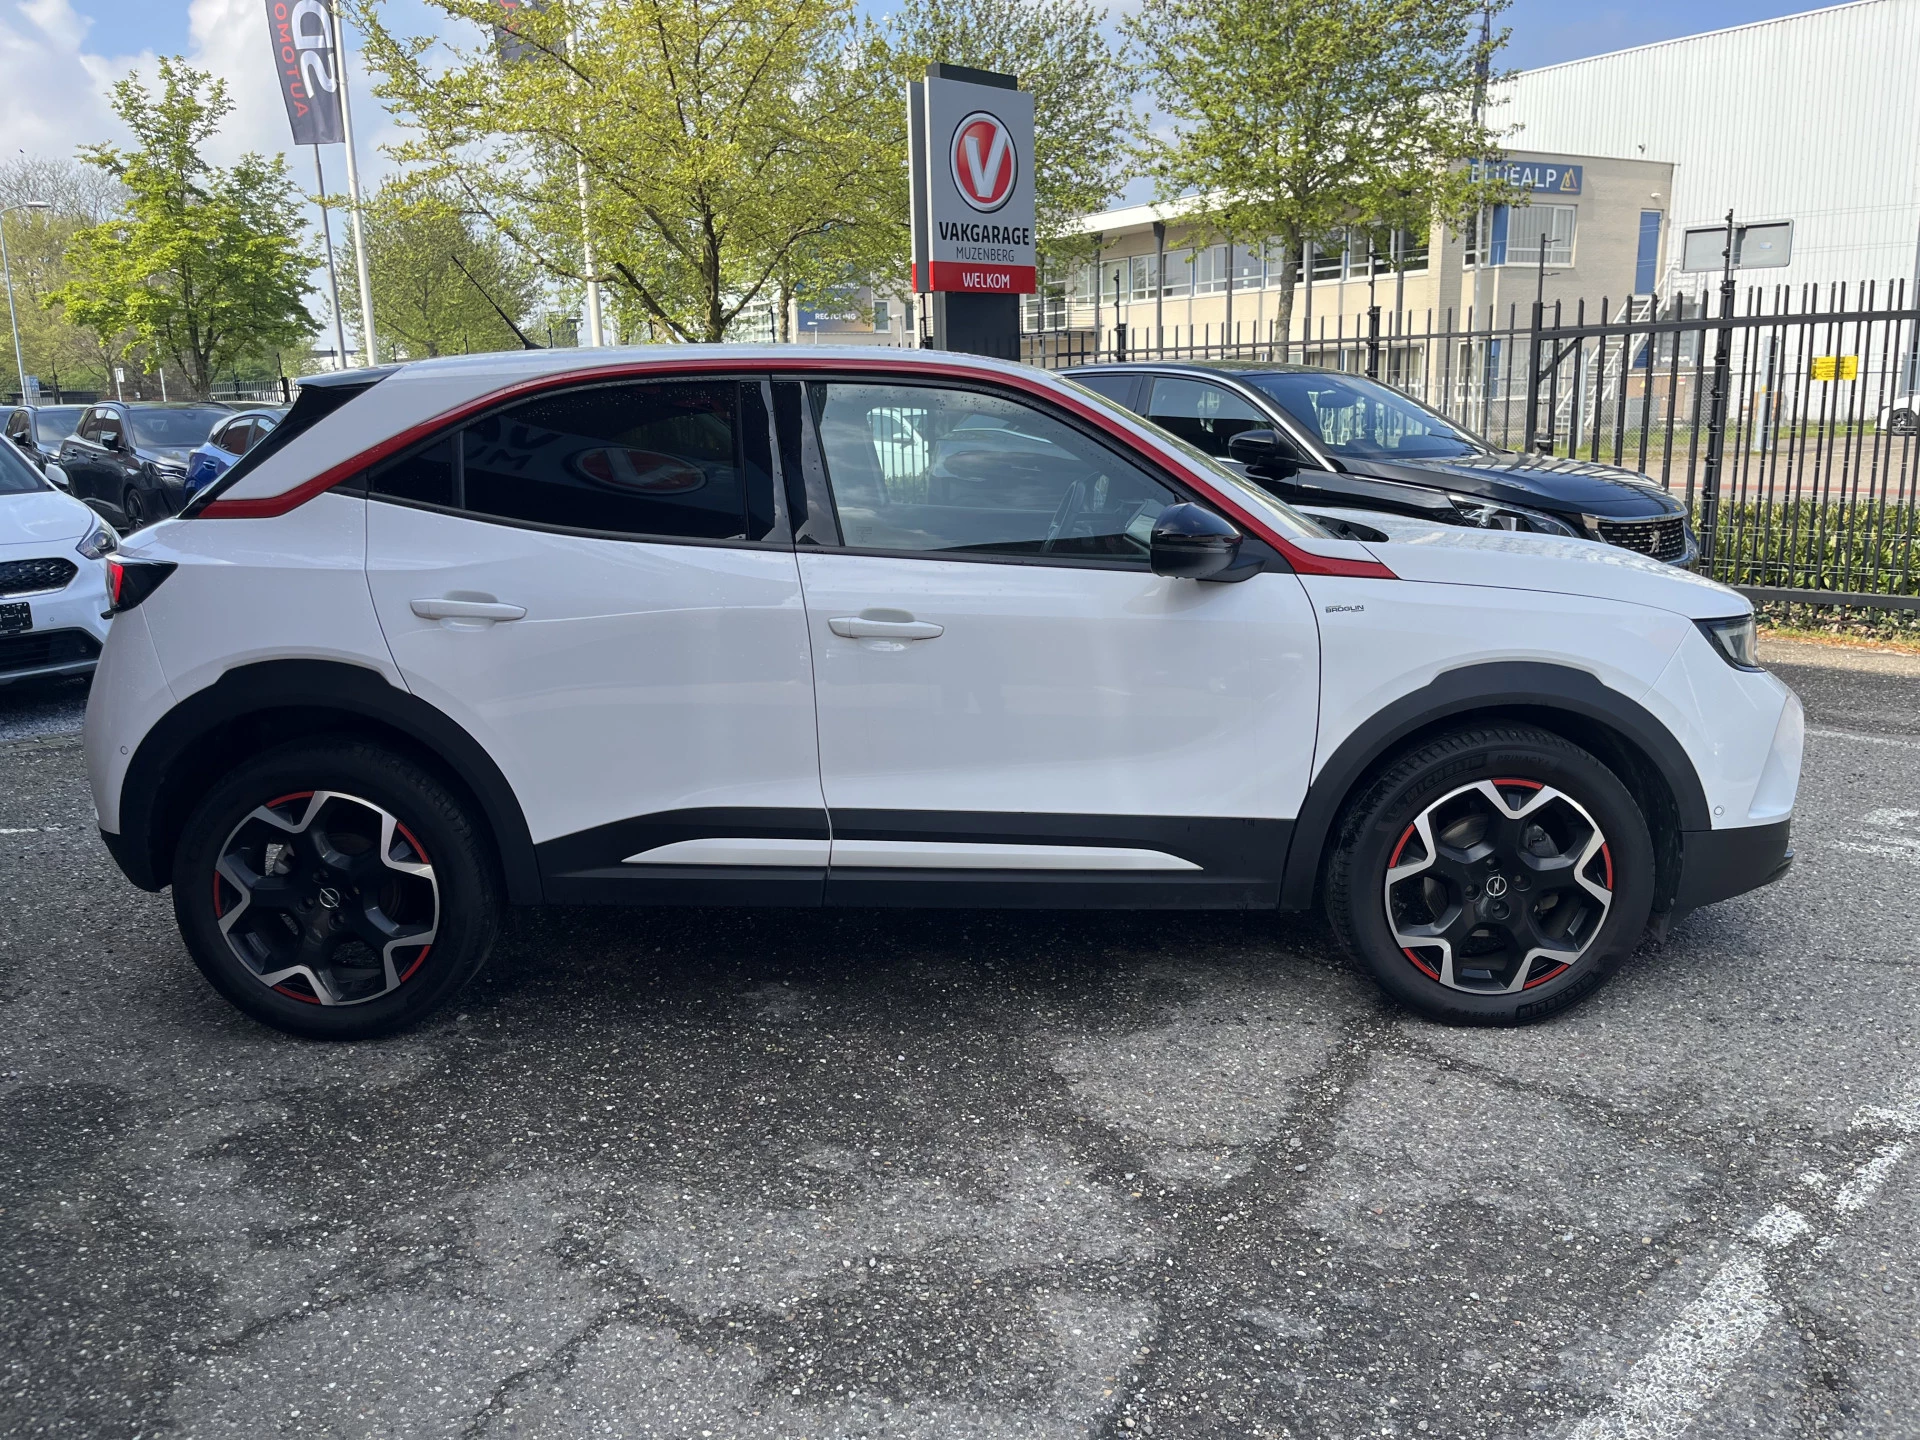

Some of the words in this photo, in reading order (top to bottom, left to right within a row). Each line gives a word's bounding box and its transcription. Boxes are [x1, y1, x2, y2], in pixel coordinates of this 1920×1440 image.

[939, 221, 1030, 246] VAKGARAGE
[956, 246, 1015, 263] MUZENBERG
[962, 272, 1011, 289] WELKOM
[1403, 753, 1487, 804] MICHELIN
